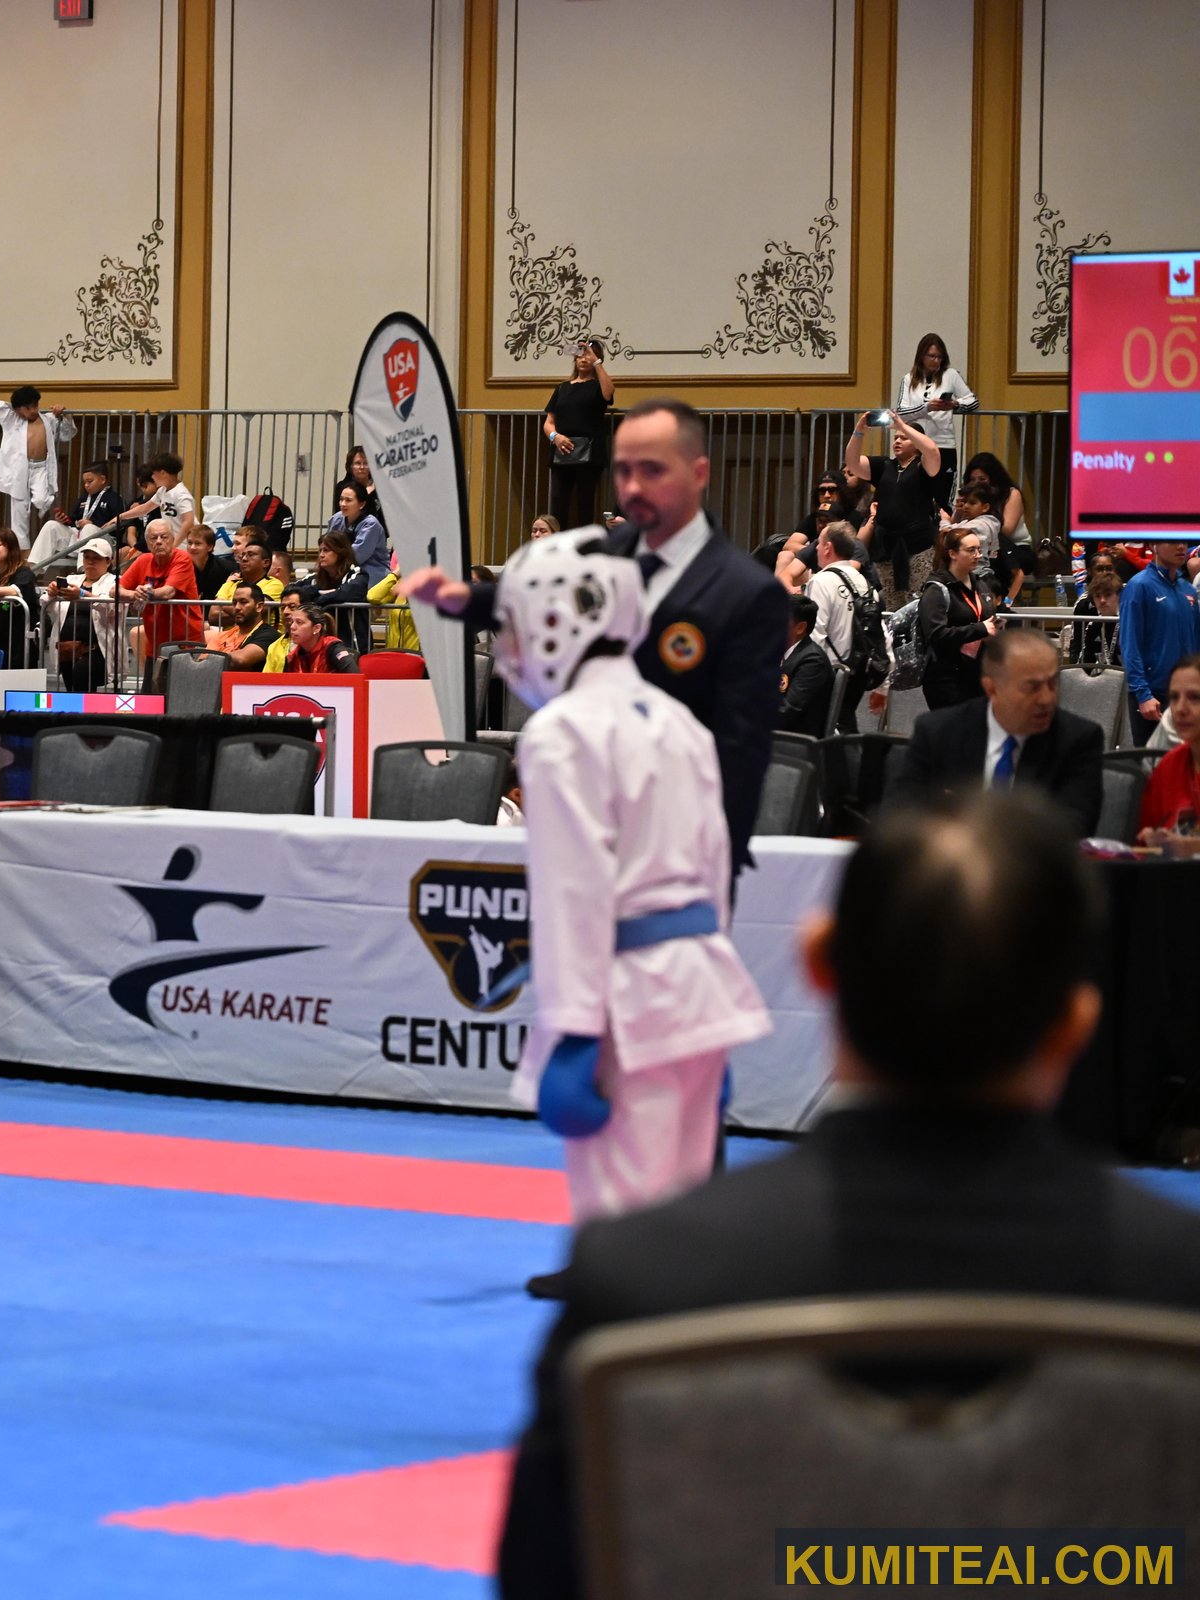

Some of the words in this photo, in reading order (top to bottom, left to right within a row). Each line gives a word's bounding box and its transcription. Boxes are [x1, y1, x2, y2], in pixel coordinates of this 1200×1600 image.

[388, 350, 415, 378] USA
[386, 424, 425, 446] NATIONAL
[374, 434, 439, 470] KARATE-DO
[1072, 449, 1135, 474] Penalty
[388, 459, 427, 479] FEDERATION
[161, 984, 212, 1015] USA
[220, 989, 332, 1026] KARATE
[381, 1015, 527, 1072] CENTU
